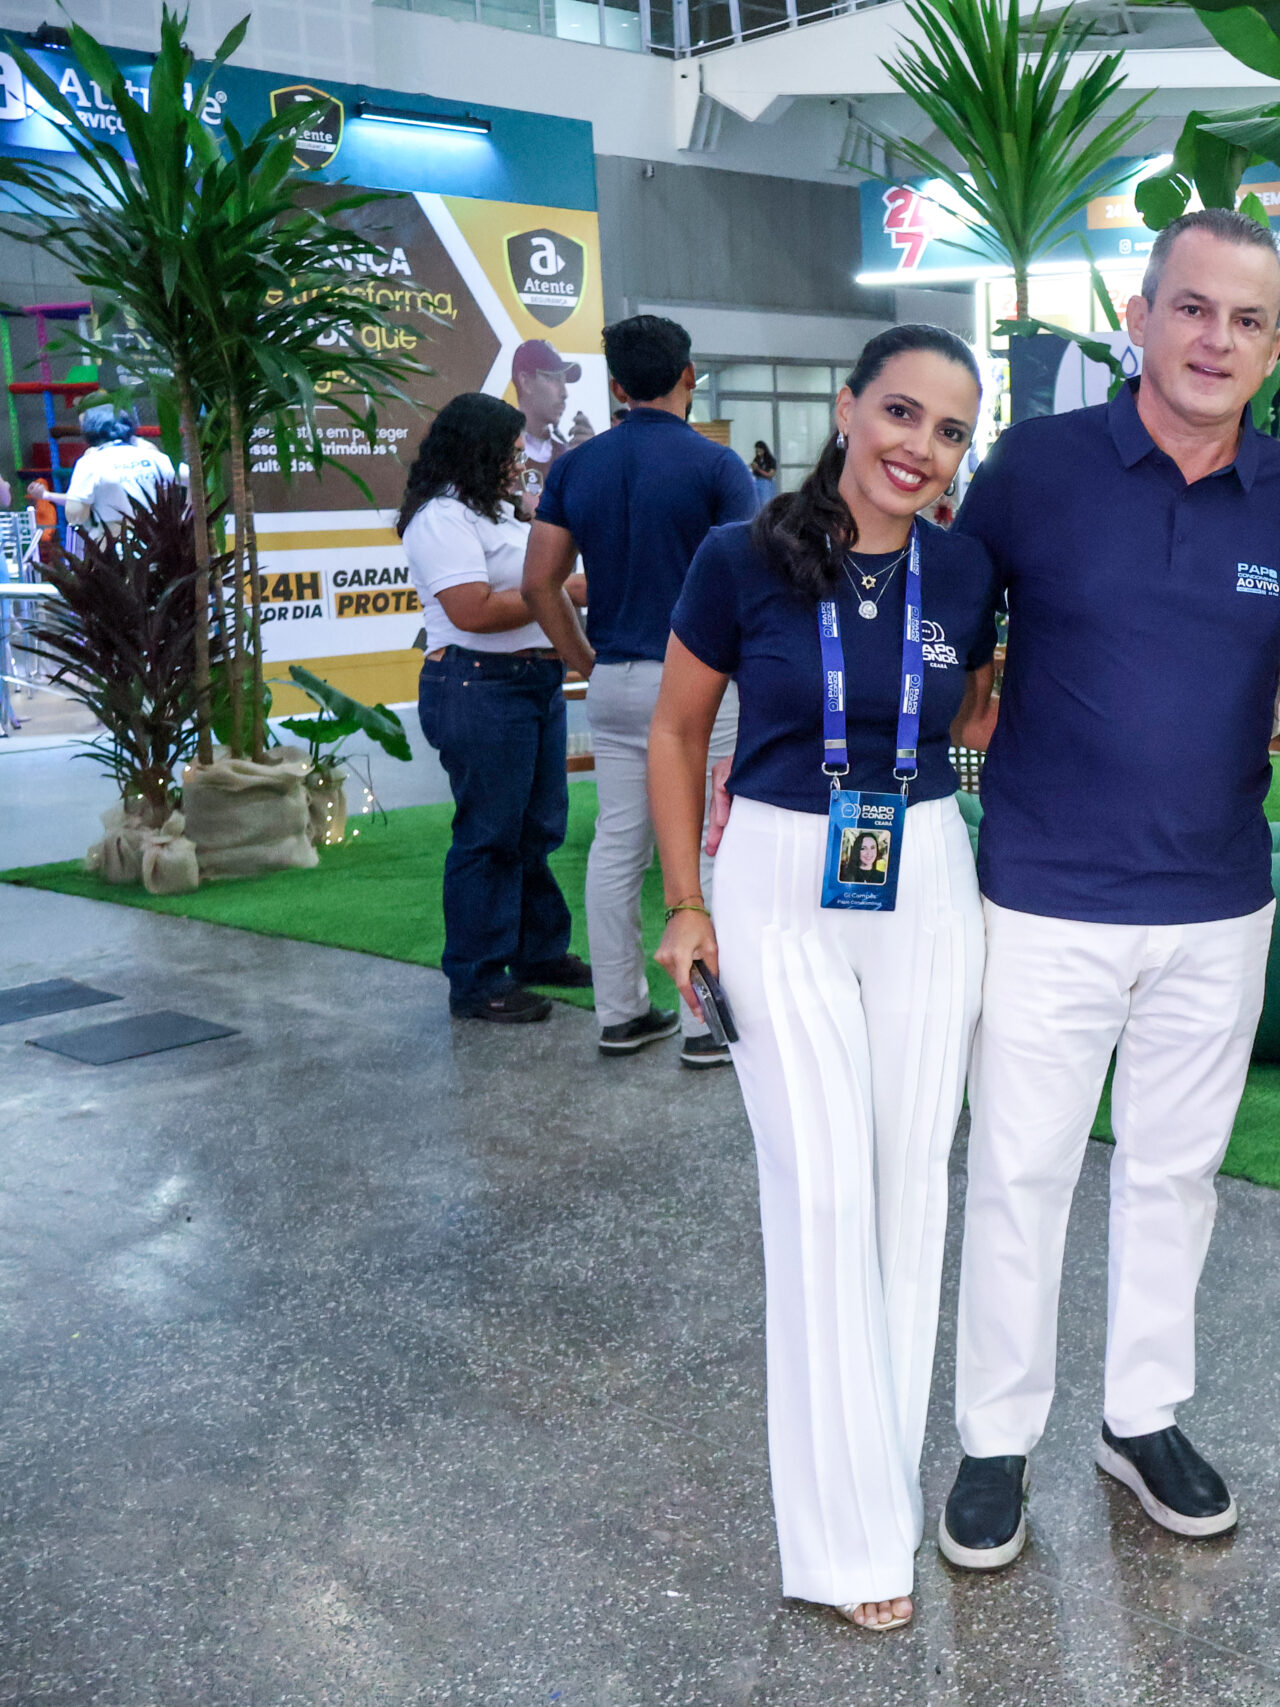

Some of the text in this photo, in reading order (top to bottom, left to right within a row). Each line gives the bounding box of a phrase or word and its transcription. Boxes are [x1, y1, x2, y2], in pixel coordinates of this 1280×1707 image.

[892, 229, 927, 270] 7
[523, 278, 575, 294] Atente
[326, 428, 349, 439] em
[333, 567, 409, 588] GARAN
[1237, 562, 1278, 579] PAPO
[1236, 577, 1254, 588] AO
[1255, 579, 1280, 593] VIVO
[337, 589, 424, 616] PROTE
[292, 605, 323, 620] DIA
[922, 644, 956, 657] APO
[922, 653, 959, 665] ONDO
[862, 805, 894, 814] PAPO
